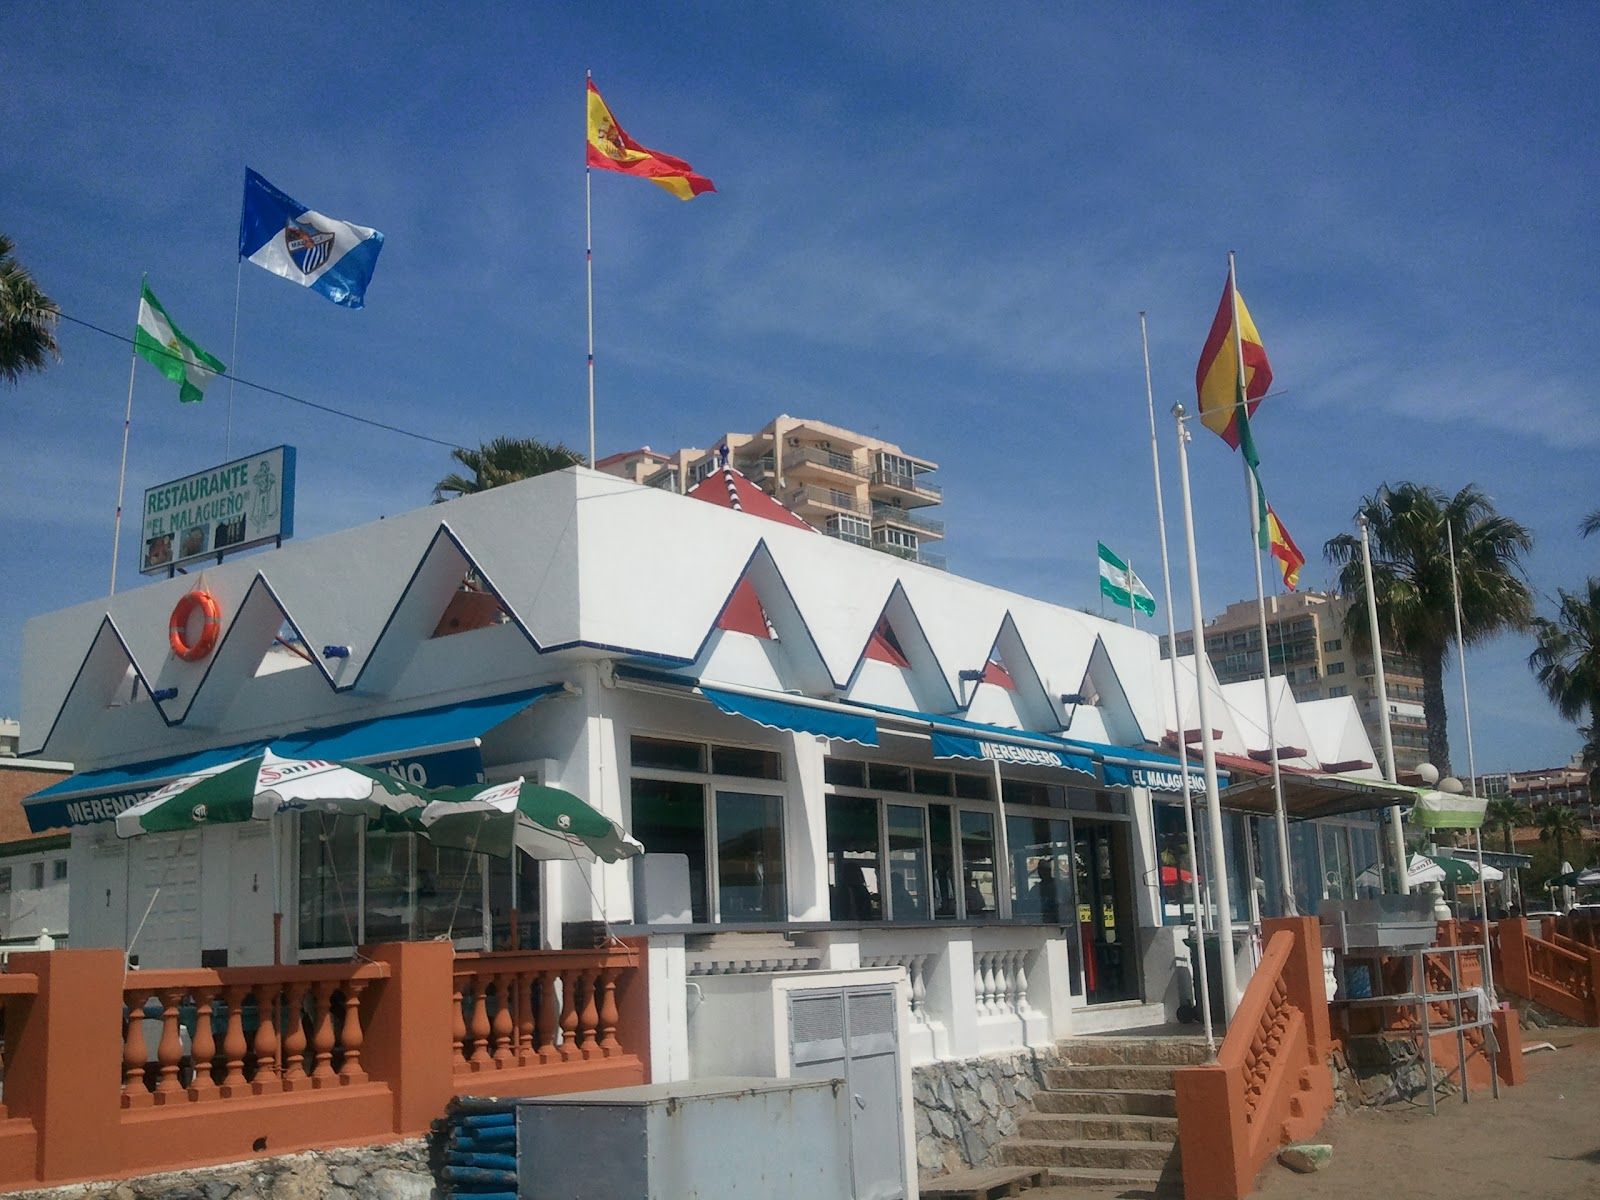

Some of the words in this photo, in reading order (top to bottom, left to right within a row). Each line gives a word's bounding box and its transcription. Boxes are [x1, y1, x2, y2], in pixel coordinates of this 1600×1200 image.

[147, 464, 249, 515] RESTAURANTE
[979, 742, 1062, 766] MERENDERO
[258, 764, 309, 784] San
[1132, 769, 1147, 785] EL
